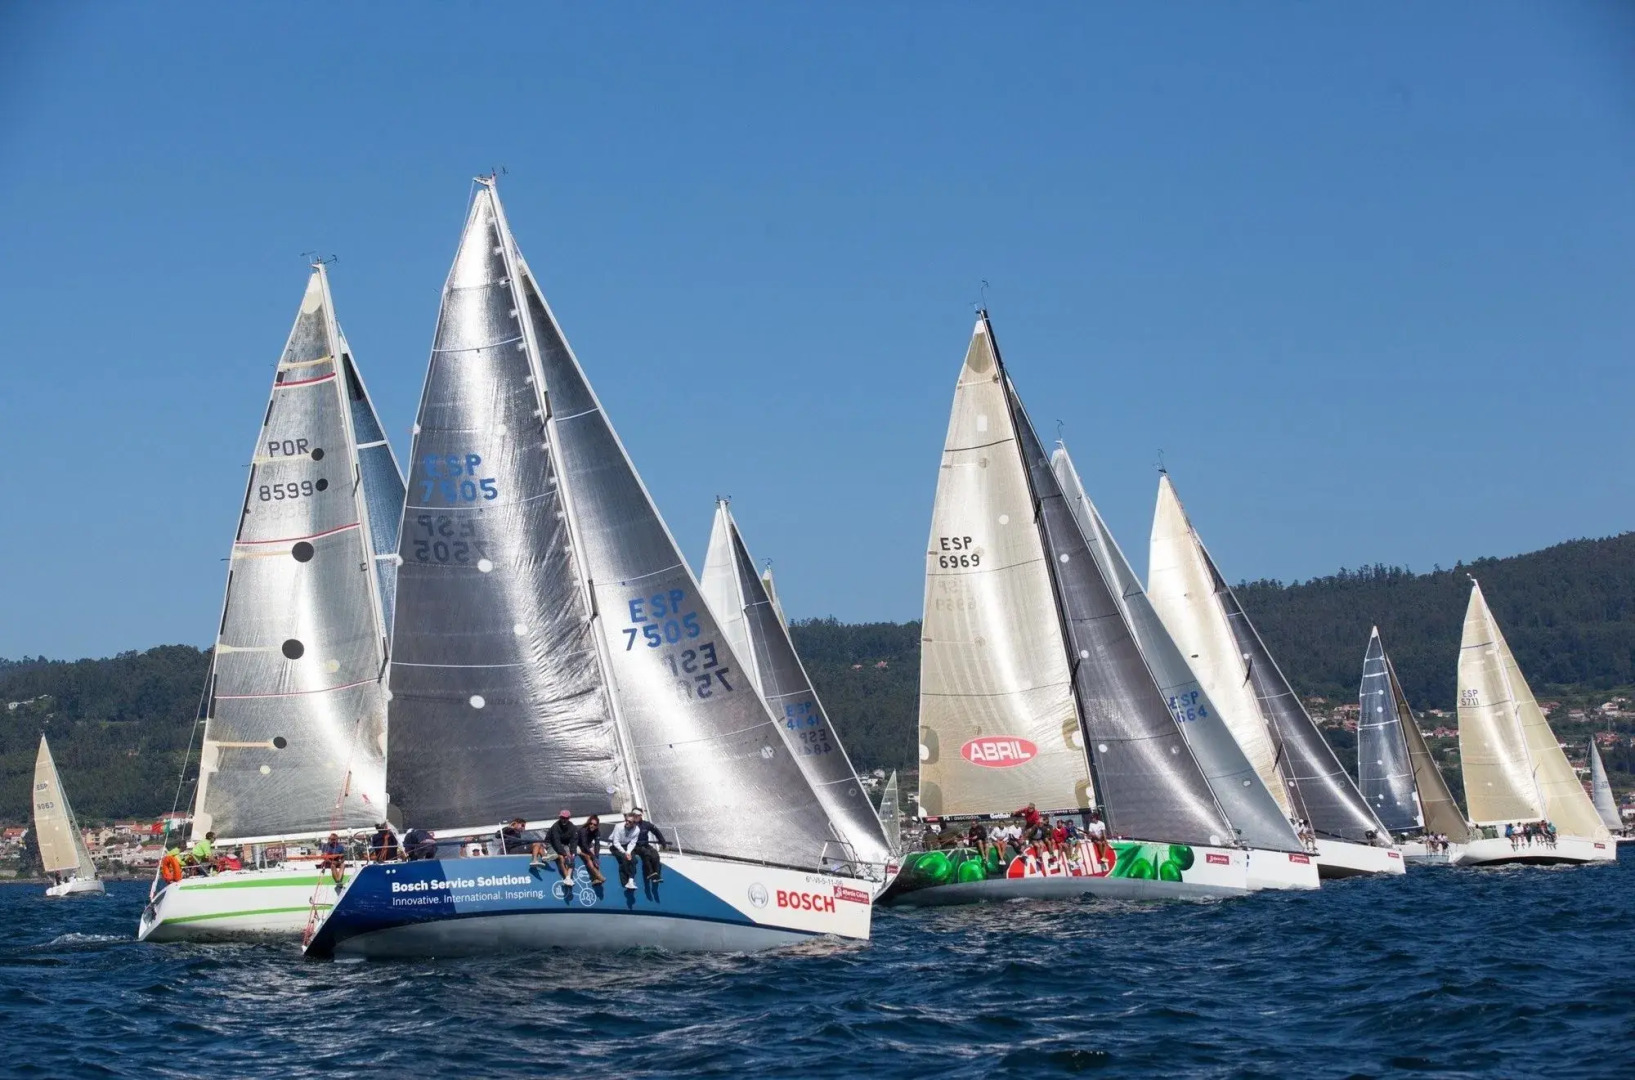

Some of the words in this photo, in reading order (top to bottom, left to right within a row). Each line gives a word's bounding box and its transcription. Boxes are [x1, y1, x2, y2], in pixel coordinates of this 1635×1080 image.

[267, 438, 310, 458] POR
[423, 452, 482, 478] ESP
[259, 480, 314, 502] 8599
[939, 536, 973, 551] ESP
[939, 553, 980, 569] 6969
[628, 588, 685, 623] ESP
[622, 611, 701, 651] 7505
[1461, 689, 1479, 698] ESP
[970, 741, 1031, 761] ABRIL
[391, 880, 429, 893] Bosch
[430, 877, 475, 890] Service
[477, 874, 532, 887] Solutions
[392, 896, 442, 906] Innovative.
[444, 892, 504, 904] International.
[505, 889, 546, 901] Inspiring.
[776, 890, 836, 913] BOSCH
